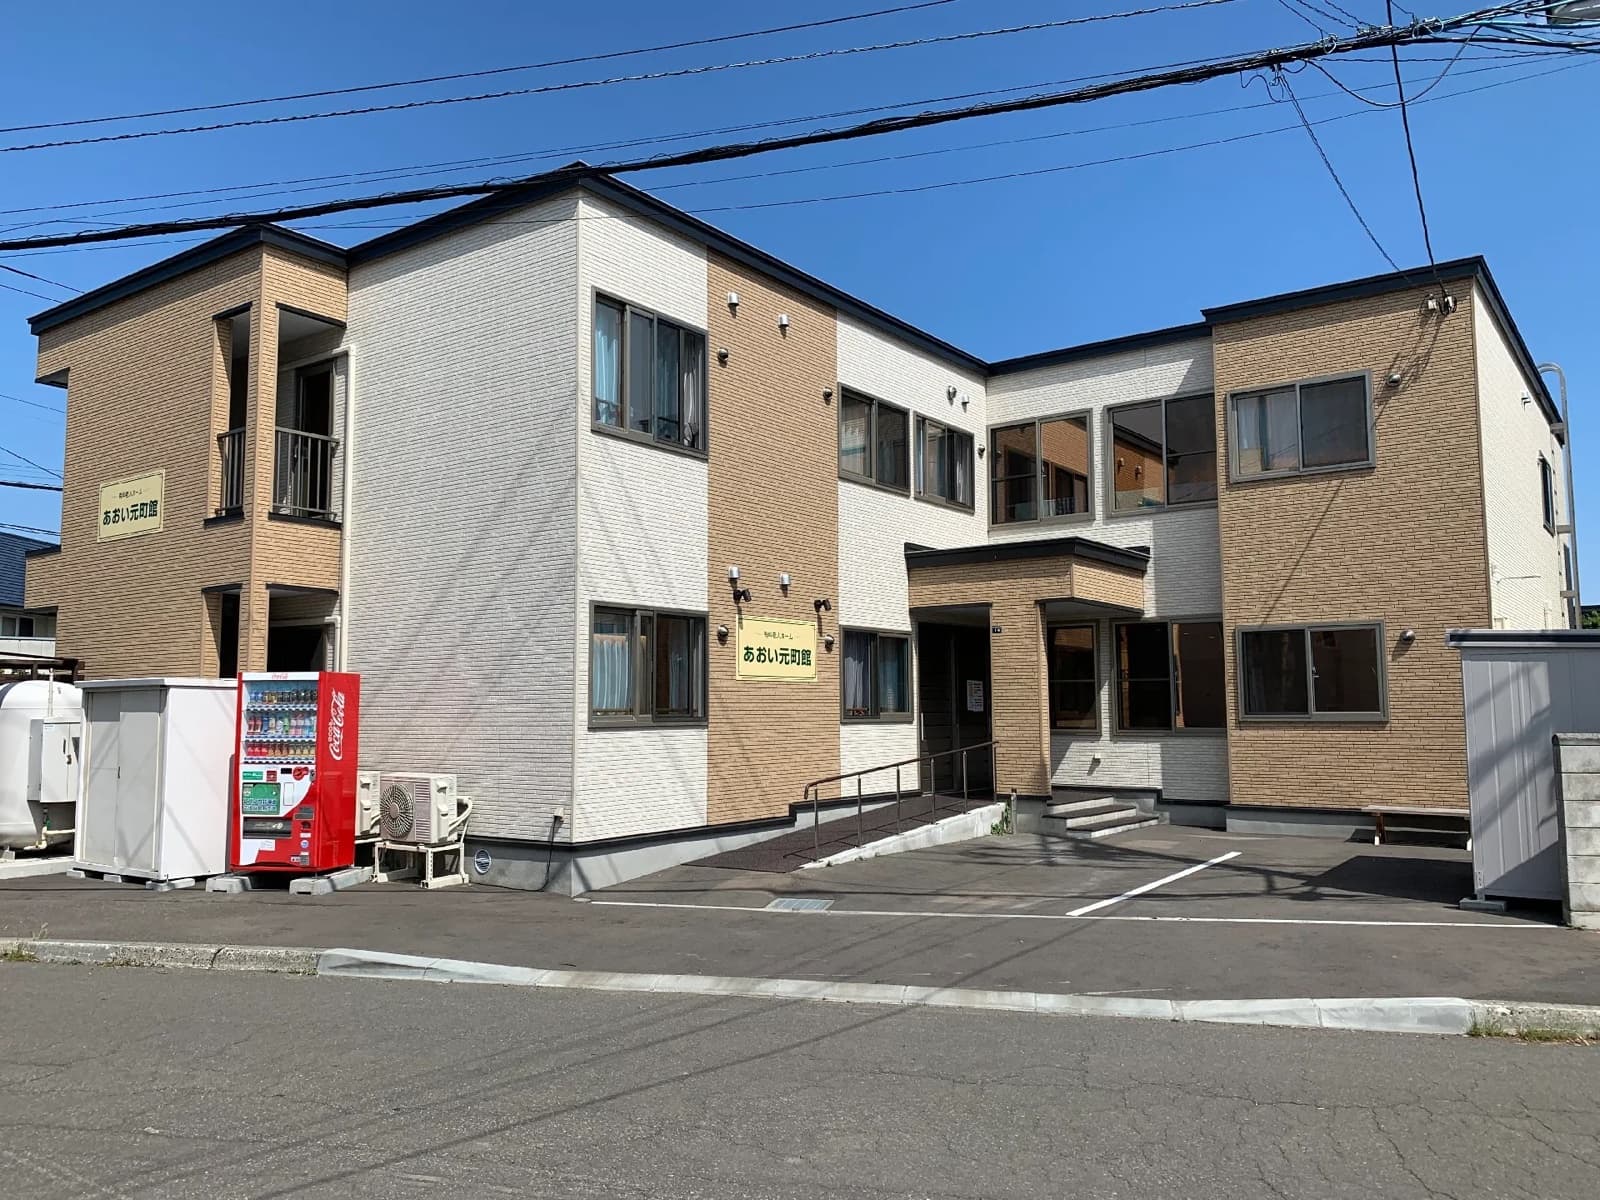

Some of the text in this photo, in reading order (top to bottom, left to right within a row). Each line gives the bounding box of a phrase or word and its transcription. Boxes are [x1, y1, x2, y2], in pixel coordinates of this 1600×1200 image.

[102, 500, 158, 525] あおい元町館
[743, 646, 812, 666] あおい元町館
